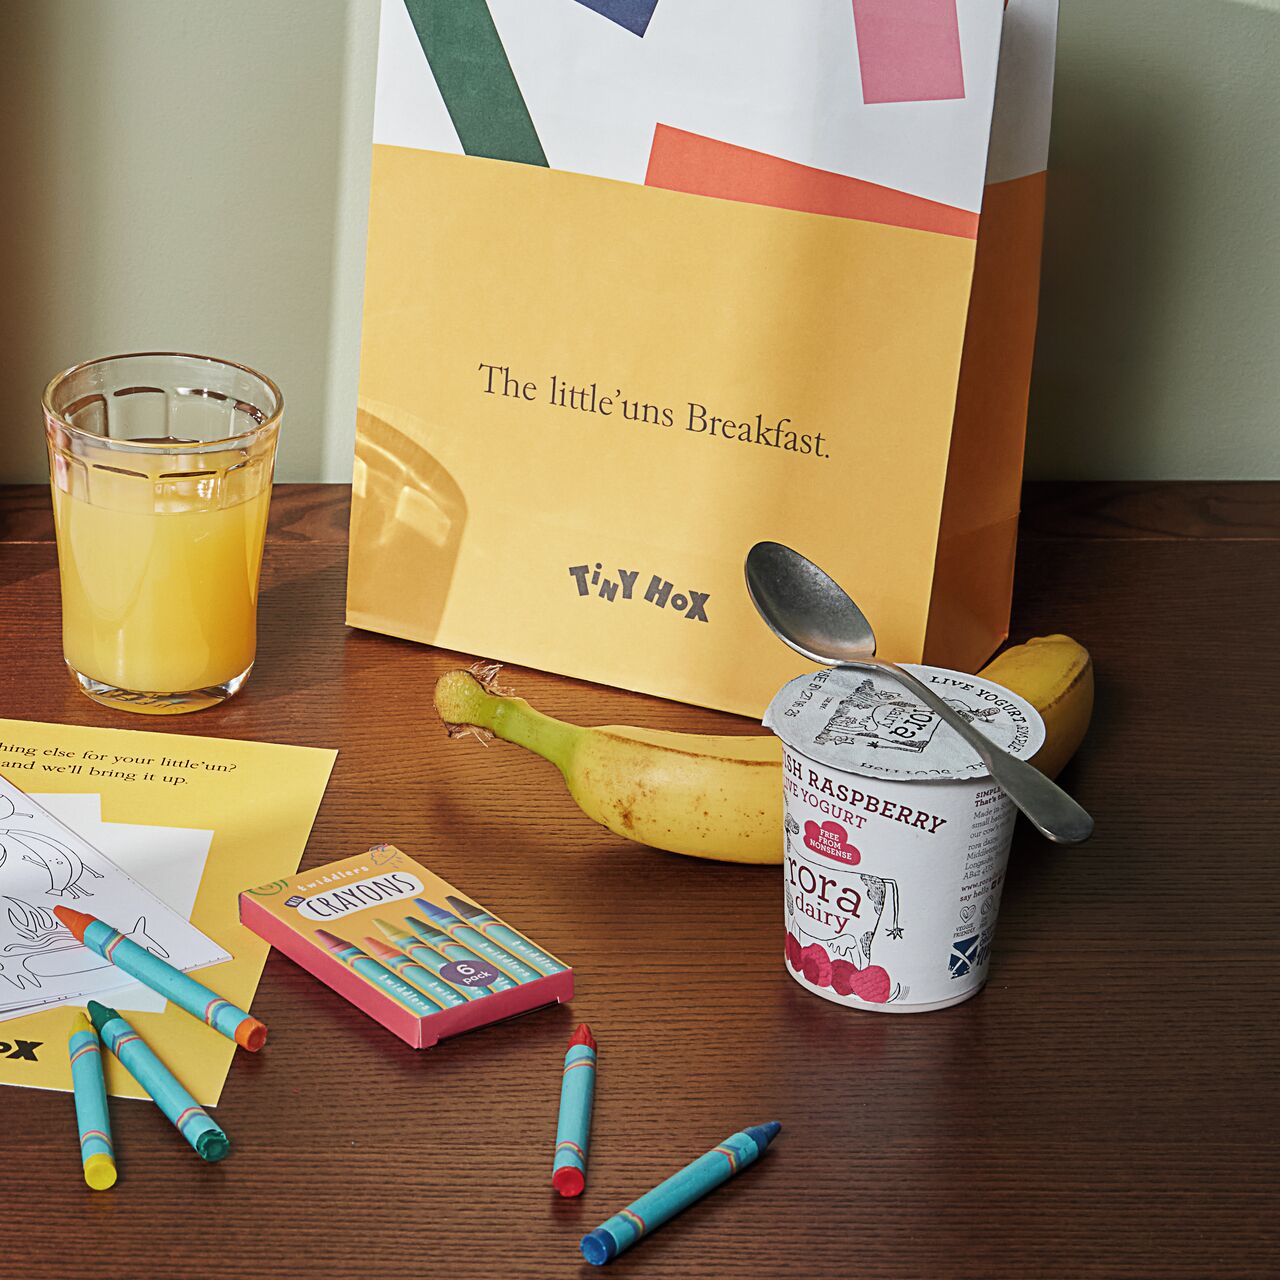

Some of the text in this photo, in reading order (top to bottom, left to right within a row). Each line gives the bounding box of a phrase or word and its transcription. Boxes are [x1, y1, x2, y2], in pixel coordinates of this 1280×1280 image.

[478, 363, 830, 459] The little'uns Breakfast.
[930, 676, 975, 691] LIVE
[976, 688, 1027, 724] YOGURT
[888, 708, 935, 738] rora
[1, 760, 35, 771] and
[42, 763, 83, 775] we'll
[89, 767, 137, 781] bring
[143, 771, 156, 782] it
[162, 775, 189, 786] up.
[43, 747, 76, 759] else
[82, 750, 108, 762] for
[114, 755, 156, 767] your
[801, 788, 868, 829] YOGURT
[808, 769, 948, 834] RASPBERRY
[809, 839, 853, 861] NONSENSE
[818, 836, 841, 850] FROM
[820, 828, 840, 842] FREE
[297, 864, 369, 892] twiddlers
[787, 856, 862, 919] rora
[306, 874, 416, 918] CRAYONS
[795, 891, 850, 934] dairy
[456, 964, 475, 975] 6
[478, 942, 531, 977] twiddlers
[378, 974, 431, 1011] twiddlers
[463, 970, 492, 985] pack
